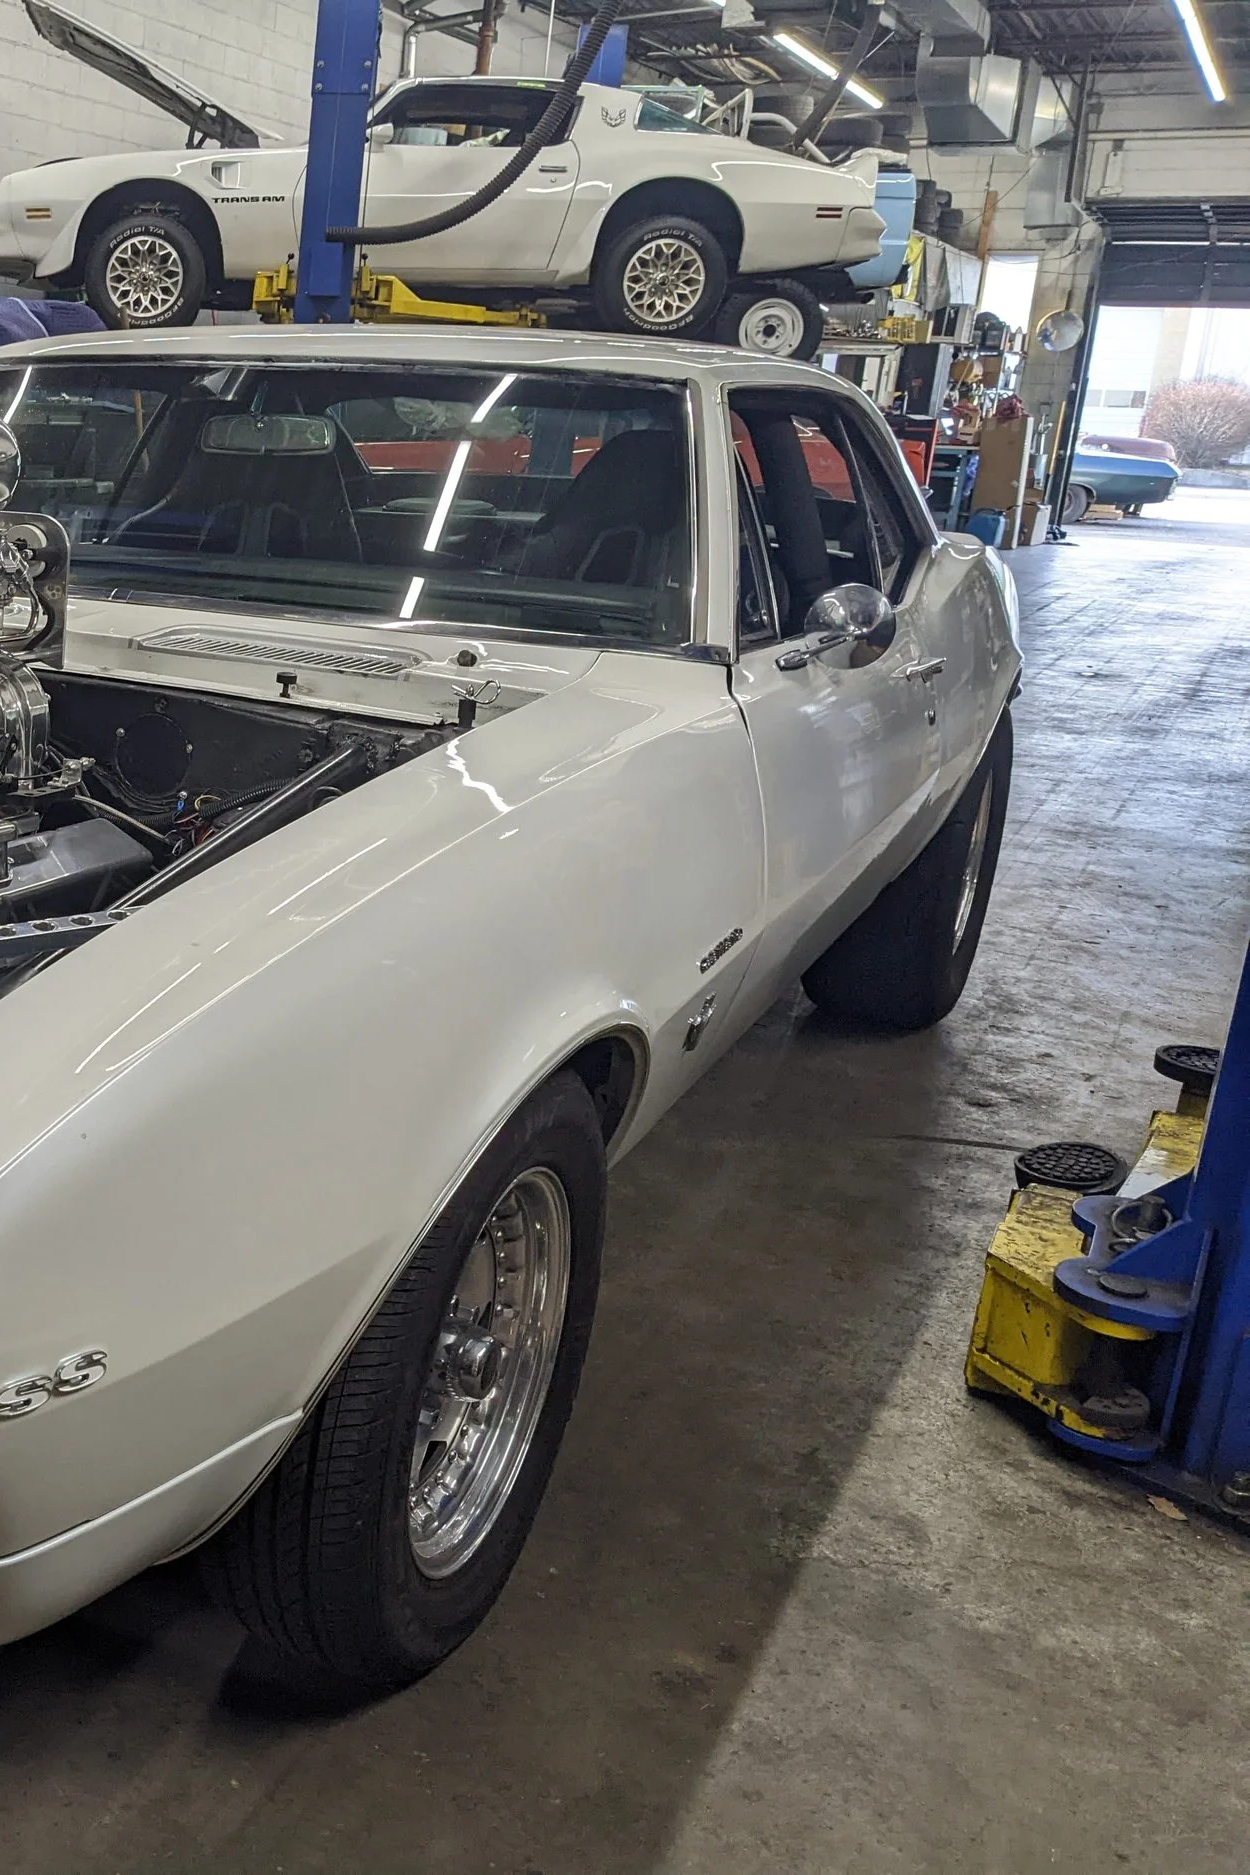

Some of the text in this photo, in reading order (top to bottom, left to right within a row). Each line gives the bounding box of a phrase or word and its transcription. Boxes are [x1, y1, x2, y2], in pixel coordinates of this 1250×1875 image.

[211, 195, 285, 204] TRANS AM
[110, 226, 165, 249] Radial T/A
[643, 228, 685, 241] Radial
